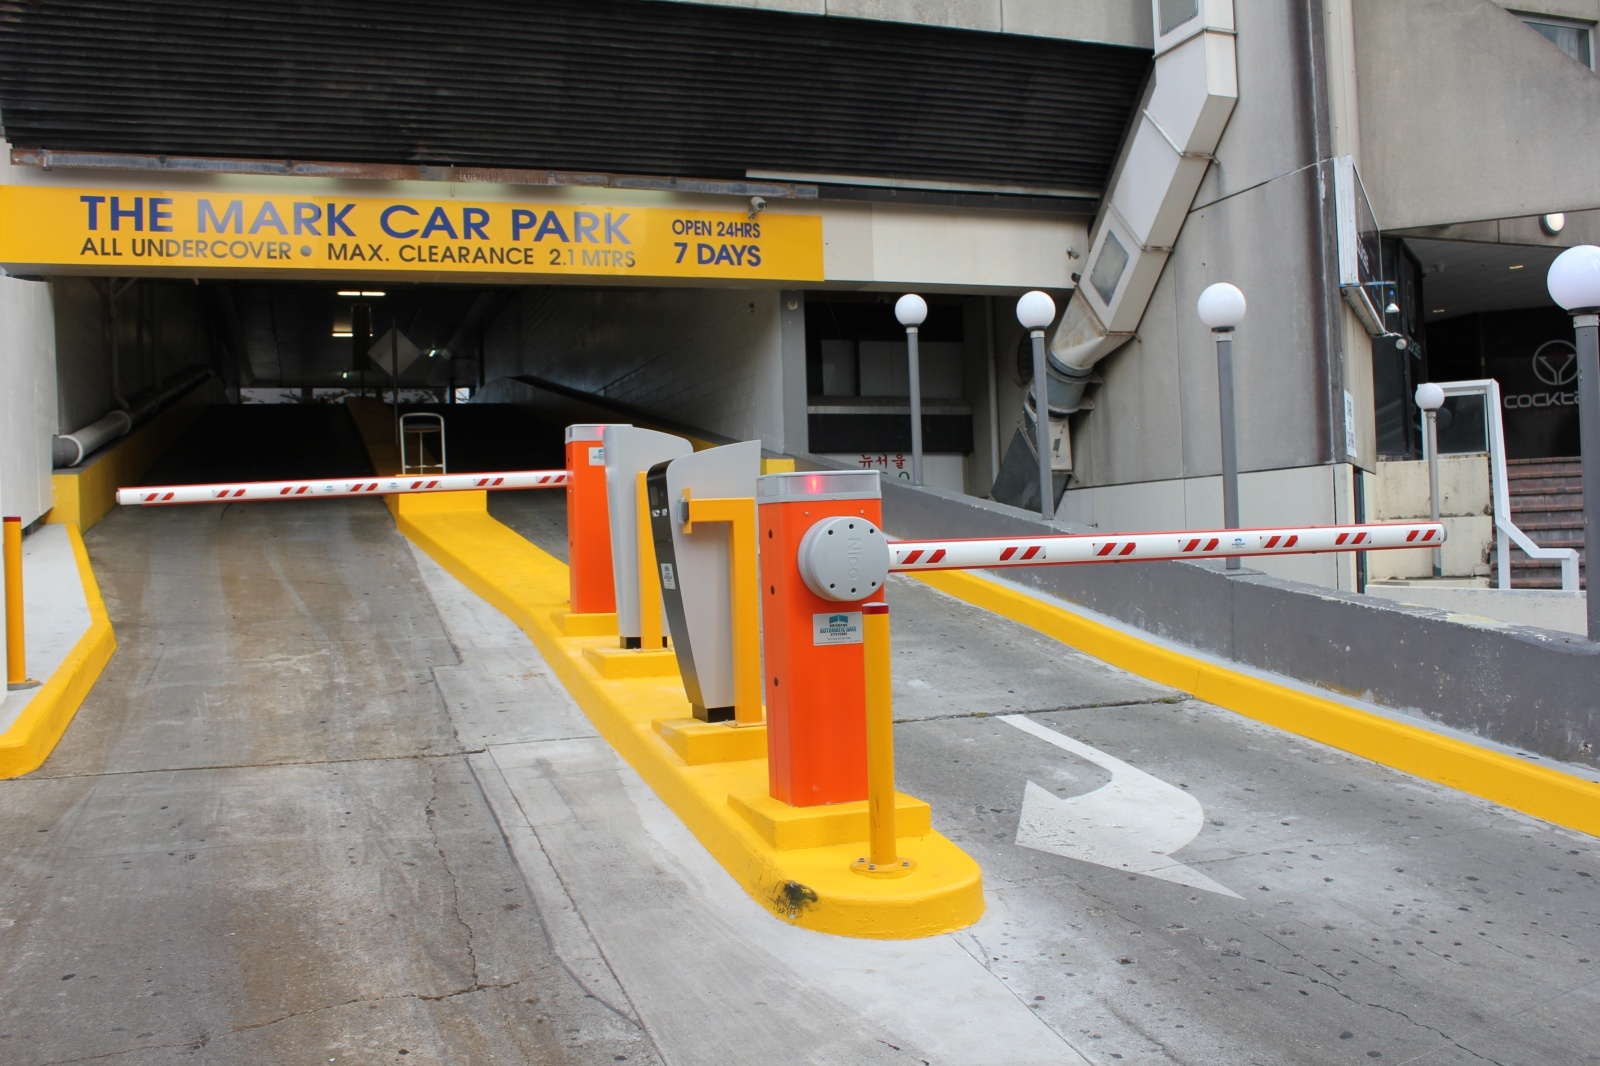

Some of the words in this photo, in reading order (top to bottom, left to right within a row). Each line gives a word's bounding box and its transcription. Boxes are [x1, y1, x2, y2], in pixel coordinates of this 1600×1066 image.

[80, 195, 174, 232] THE
[196, 198, 357, 237] MARK
[379, 204, 491, 241] CAR
[511, 208, 632, 245] PARK
[672, 219, 713, 236] OPEN
[716, 221, 761, 239] 24HRS
[80, 237, 122, 256] ALL
[131, 238, 292, 259] UNDERCOVER
[328, 243, 389, 261] MAX.
[398, 244, 534, 265] CLEARANCE
[549, 248, 575, 266] 2.1
[581, 249, 636, 268] MTRS
[674, 241, 688, 264] 7
[697, 243, 761, 267] DAYS
[858, 453, 906, 470] 뉴서울
